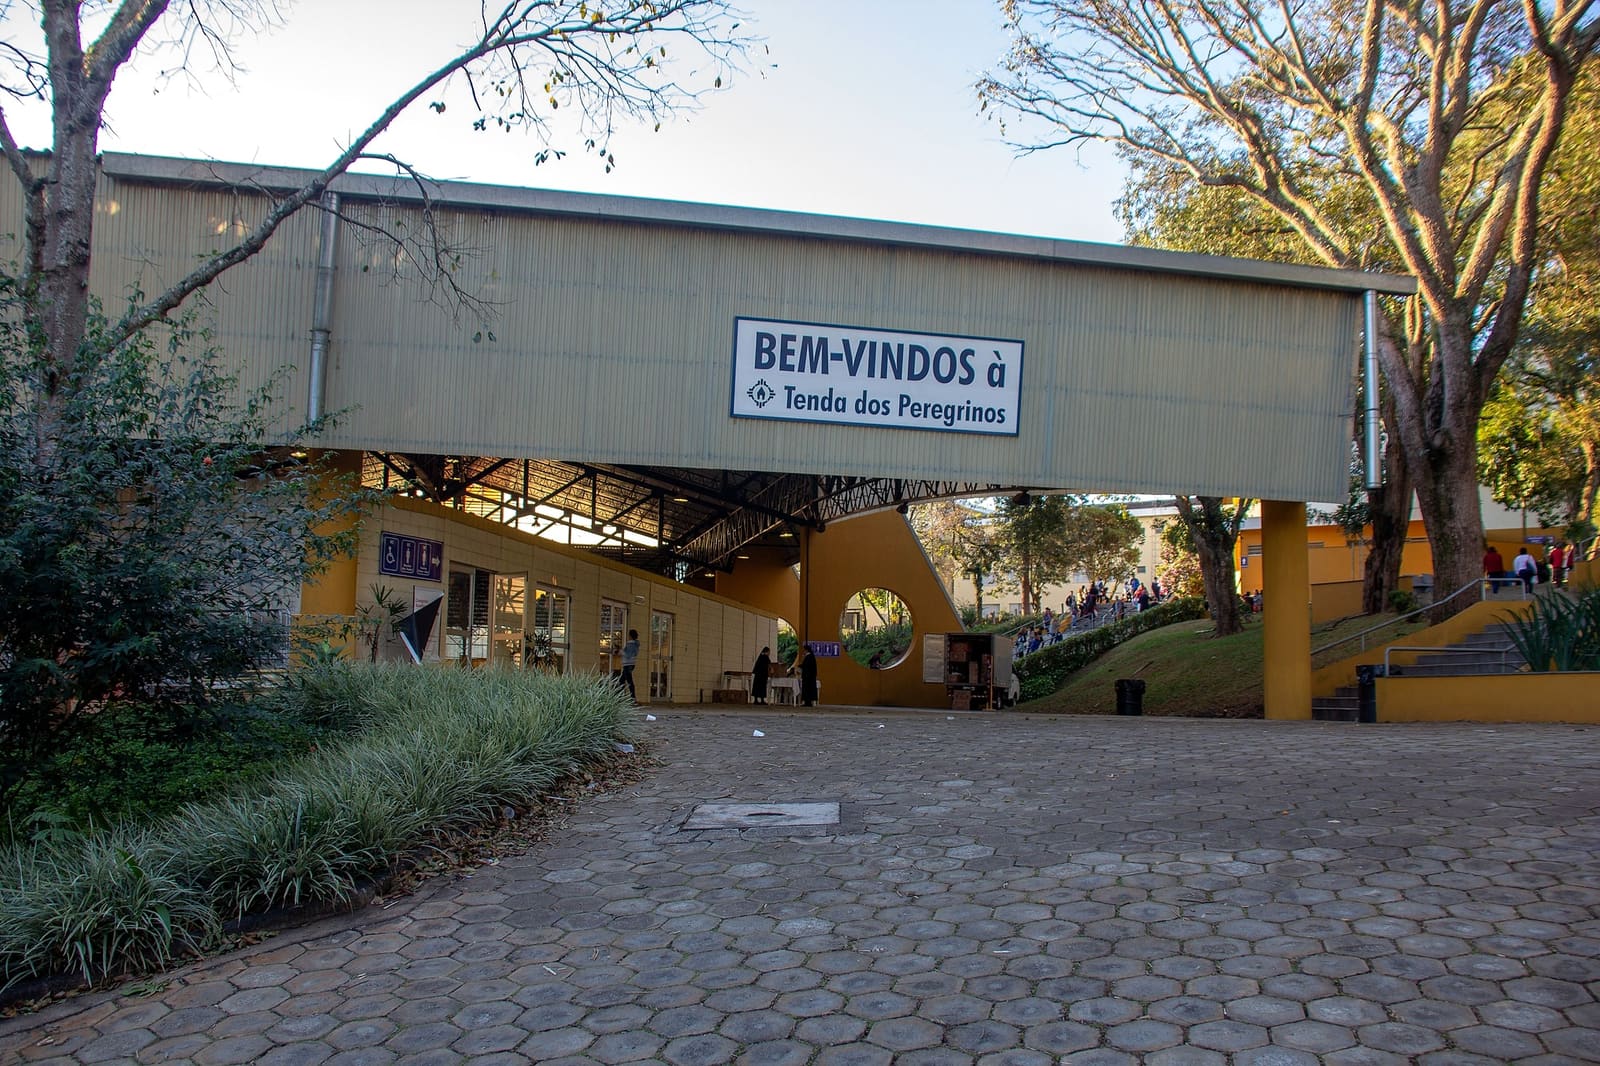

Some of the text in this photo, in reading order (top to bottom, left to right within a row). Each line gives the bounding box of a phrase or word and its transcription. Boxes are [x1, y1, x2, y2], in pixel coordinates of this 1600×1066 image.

[754, 331, 1006, 388] BEM-VINDOS à
[784, 385, 1006, 427] Tenda dos Peregrinos
